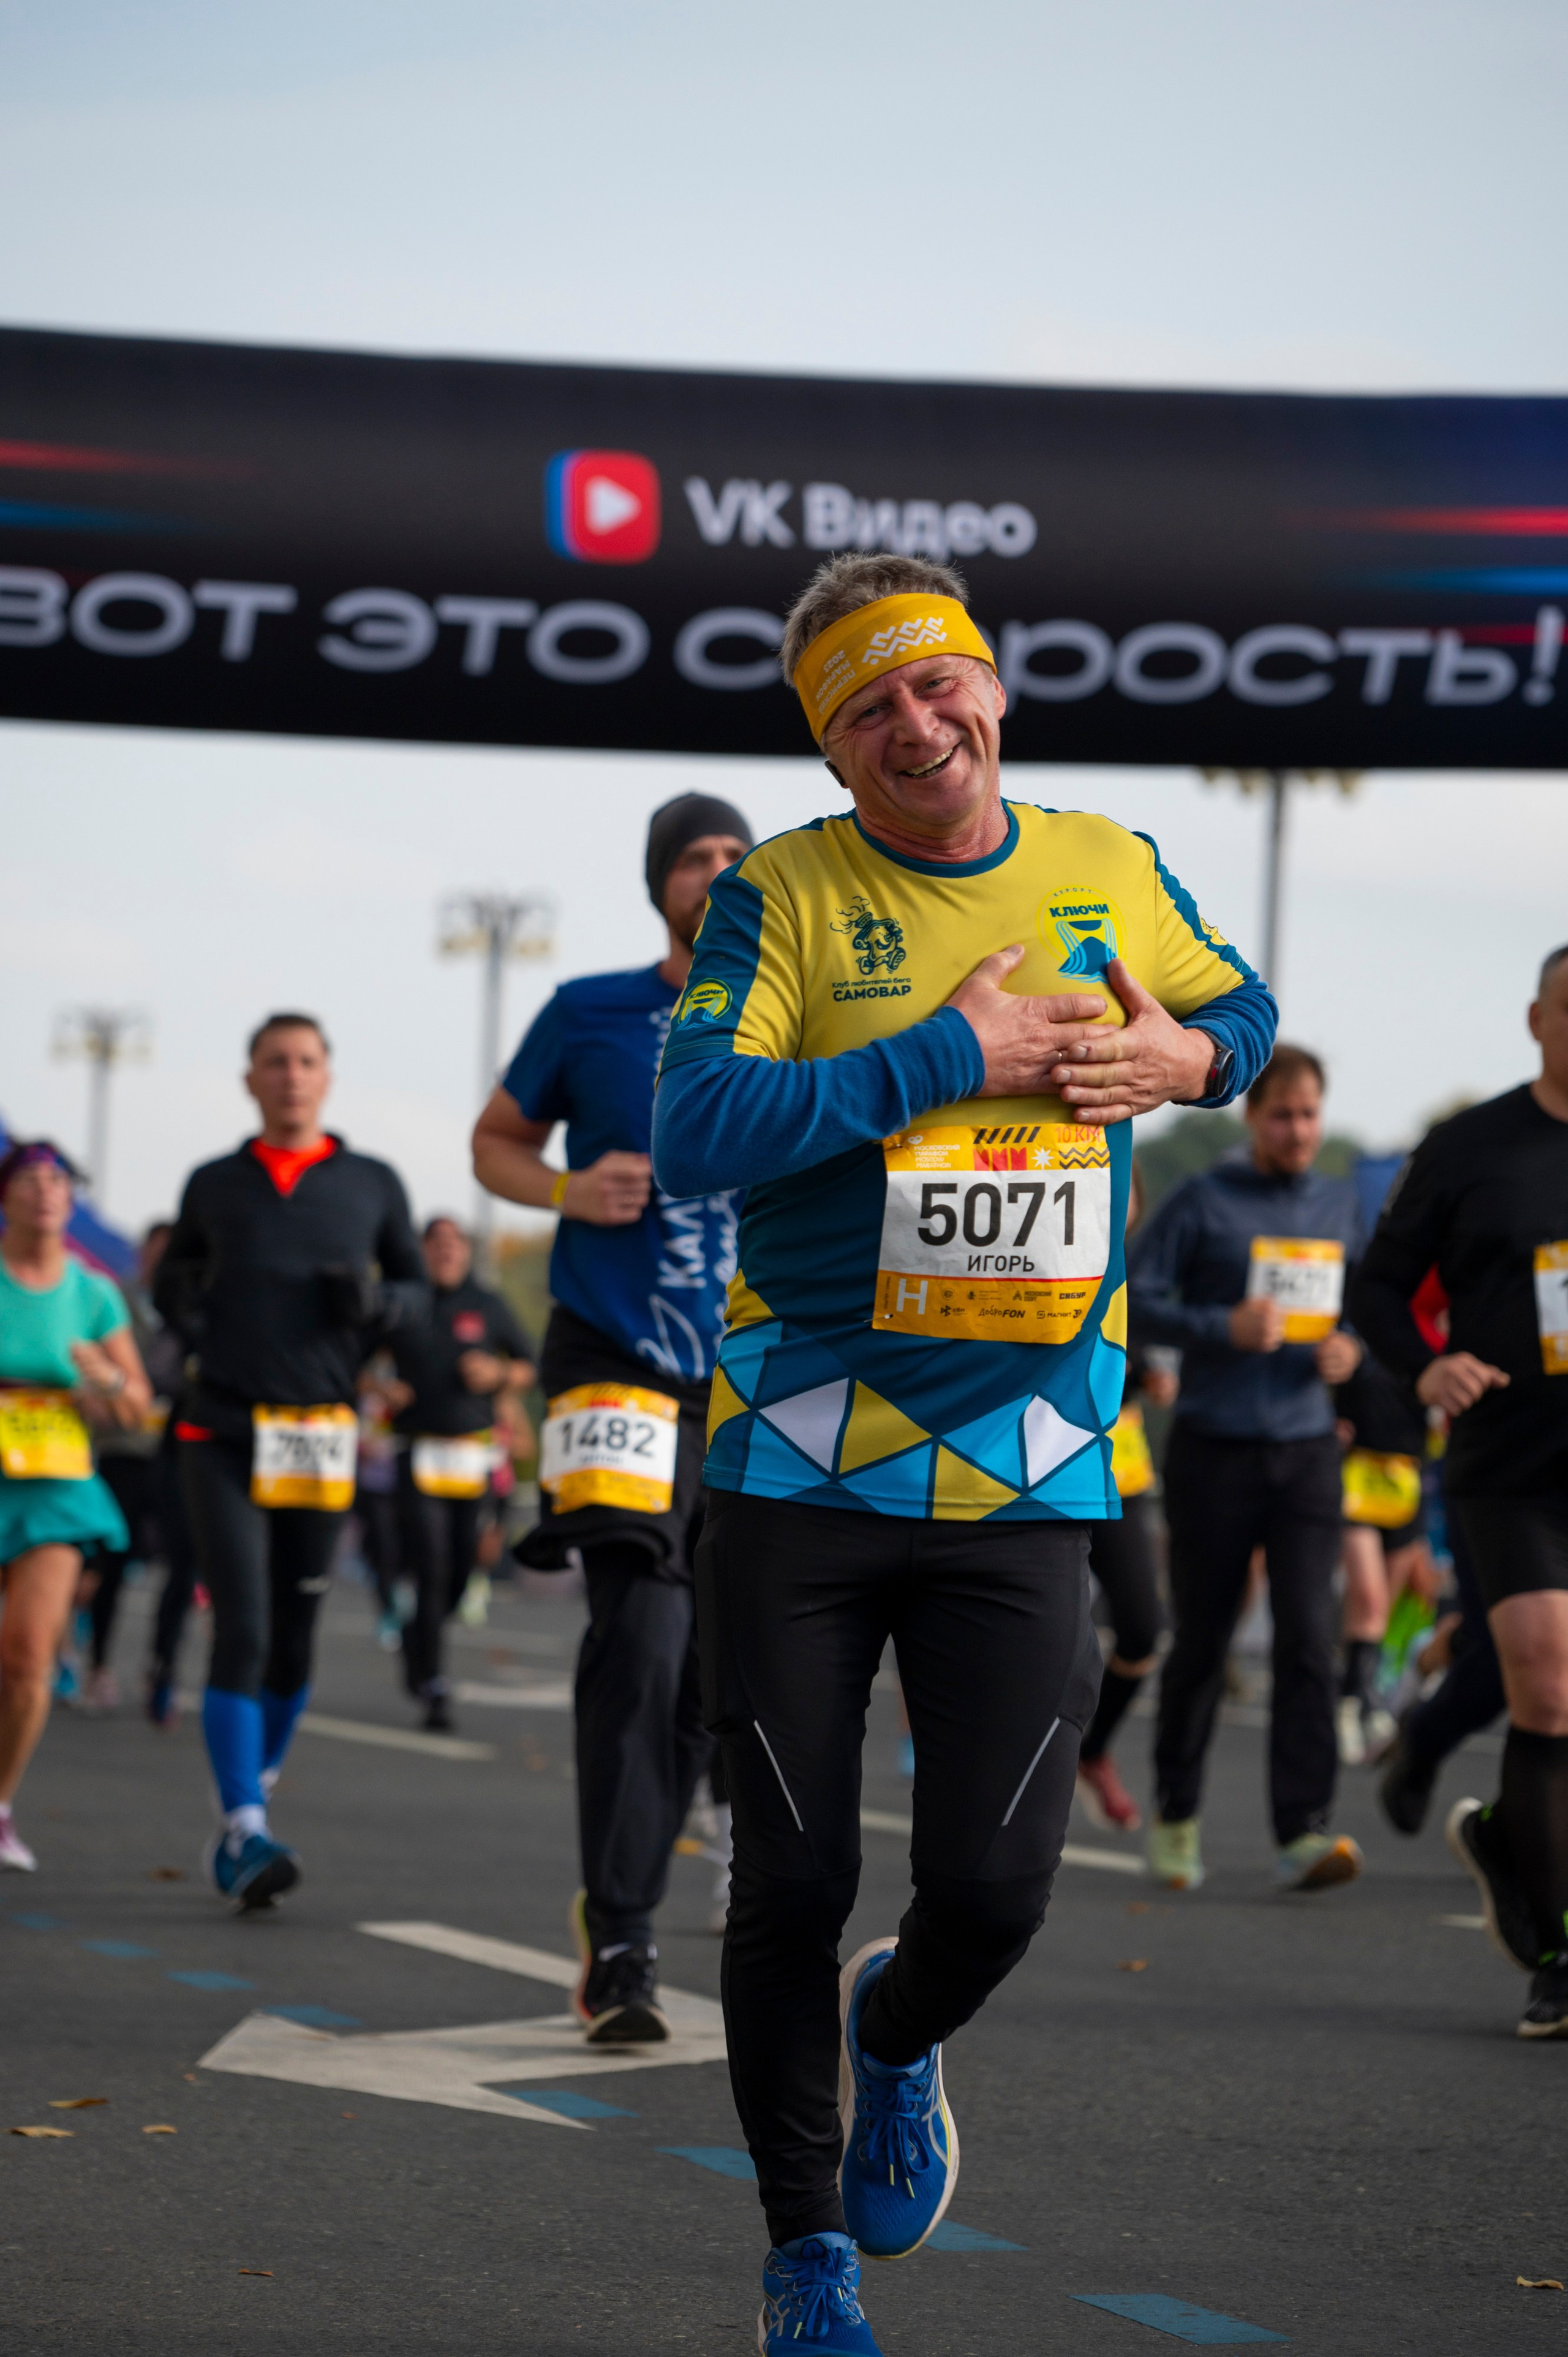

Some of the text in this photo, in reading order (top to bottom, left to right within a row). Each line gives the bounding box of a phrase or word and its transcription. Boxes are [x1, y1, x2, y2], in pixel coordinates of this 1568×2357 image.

[684, 477, 1038, 559] VK Видео
[823, 650, 845, 673] 2023
[816, 659, 851, 701] МАРАФОН
[1054, 887, 1092, 897] КУРОРТ
[1049, 903, 1110, 918] КЛЮЧИ
[832, 981, 850, 989] Клуб
[851, 978, 892, 987] любителей
[688, 989, 725, 999] КЛЮЧИ
[833, 985, 911, 1002] САМОВАР
[1055, 1126, 1071, 1143] 10
[918, 1182, 1076, 1247] 5071
[967, 1254, 1035, 1272] ИГОРЬ
[562, 1414, 655, 1458] 1482
